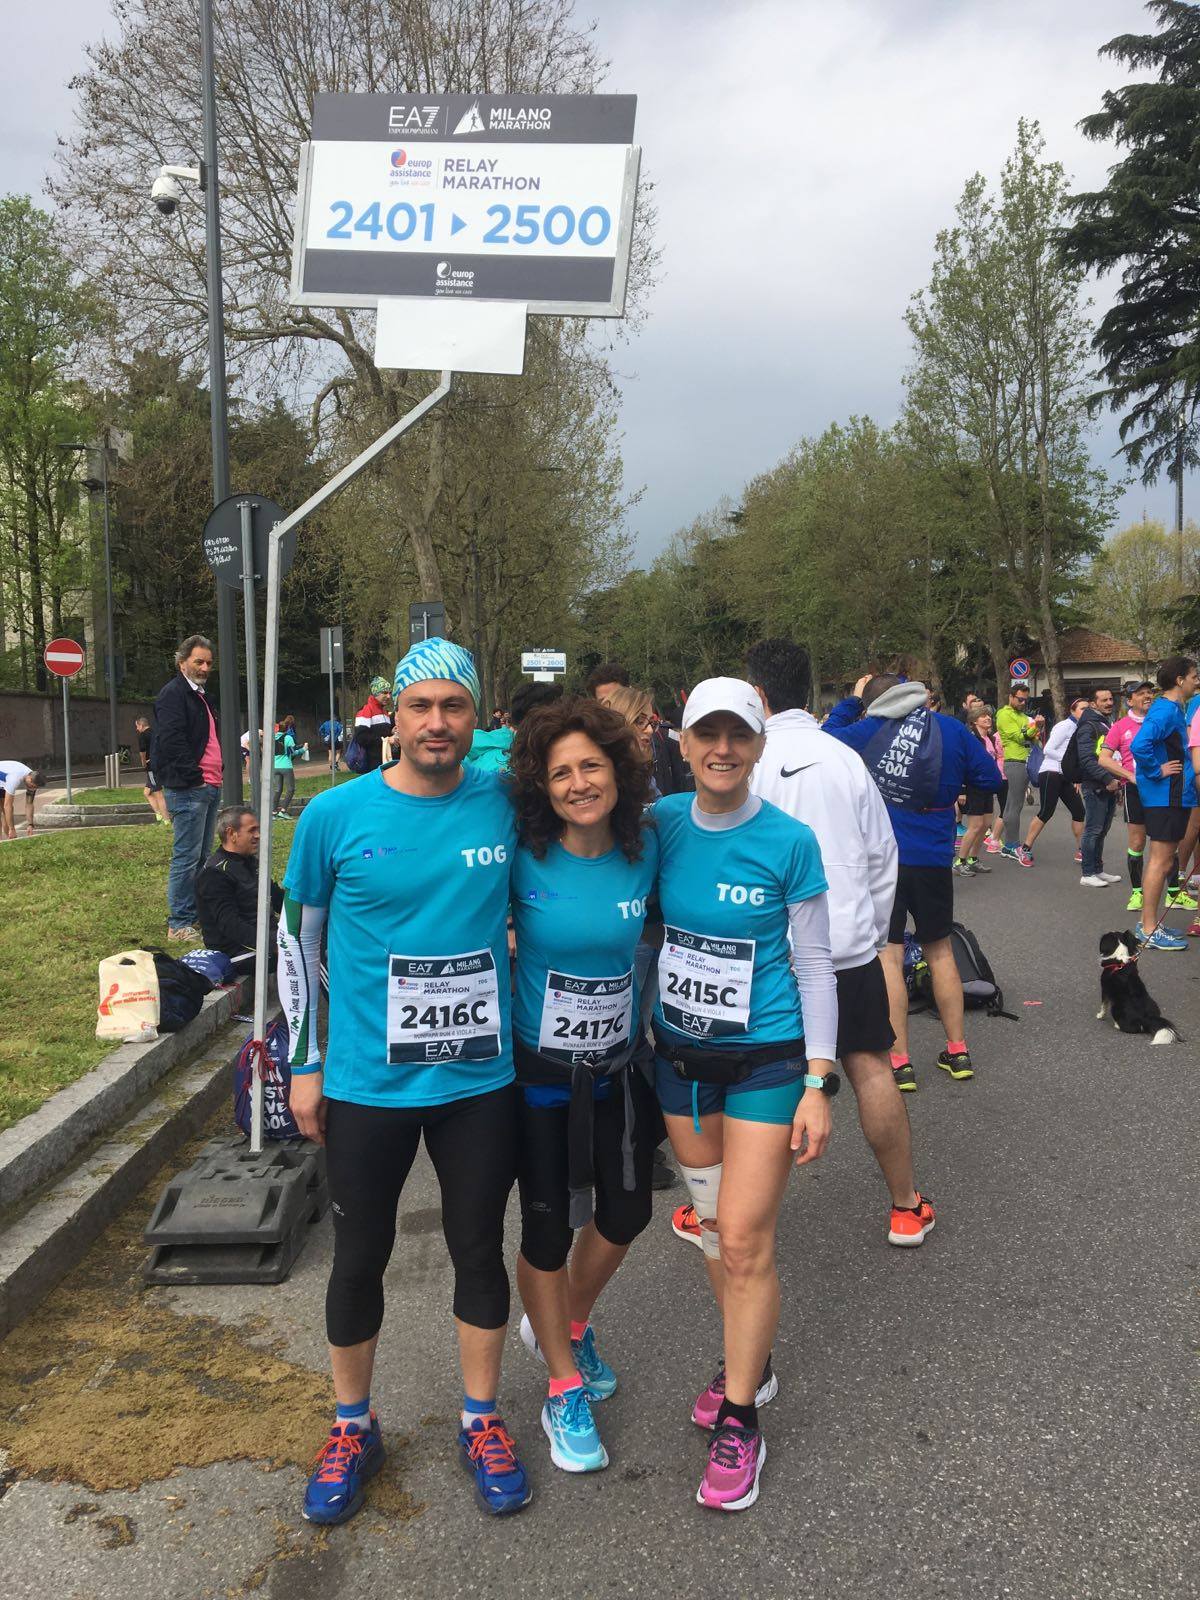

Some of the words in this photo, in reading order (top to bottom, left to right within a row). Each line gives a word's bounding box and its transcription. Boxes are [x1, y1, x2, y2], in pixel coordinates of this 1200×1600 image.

[388, 105, 440, 128] EA7
[490, 108, 552, 121] MILANO
[489, 121, 551, 130] MARATHON
[407, 160, 432, 170] europ
[444, 158, 499, 173] RELAY
[390, 168, 432, 178] assistance
[442, 176, 541, 191] MARATHON
[326, 200, 436, 242] 2401
[482, 204, 611, 246] 2500
[435, 278, 474, 287] assistance
[451, 270, 475, 280] europ
[891, 735, 919, 755] AST
[877, 760, 910, 778] COOL
[461, 844, 507, 868] TOG
[716, 882, 765, 906] TOG
[456, 958, 482, 968] MILANO
[686, 953, 706, 963] RELAY
[284, 959, 298, 977] TERRE
[408, 962, 434, 973] EA7
[685, 960, 721, 975] MARATHON
[289, 979, 300, 996] DELLE
[423, 986, 470, 995] MARATHON
[564, 979, 588, 990] EA7
[667, 972, 738, 1008] 2415C
[289, 997, 300, 1013] TRAIL
[576, 1003, 618, 1012] MARATHON
[400, 1000, 490, 1029] 2416C
[553, 1011, 626, 1040] 2417C
[681, 1012, 714, 1033] EA7
[425, 1040, 465, 1057] EA7
